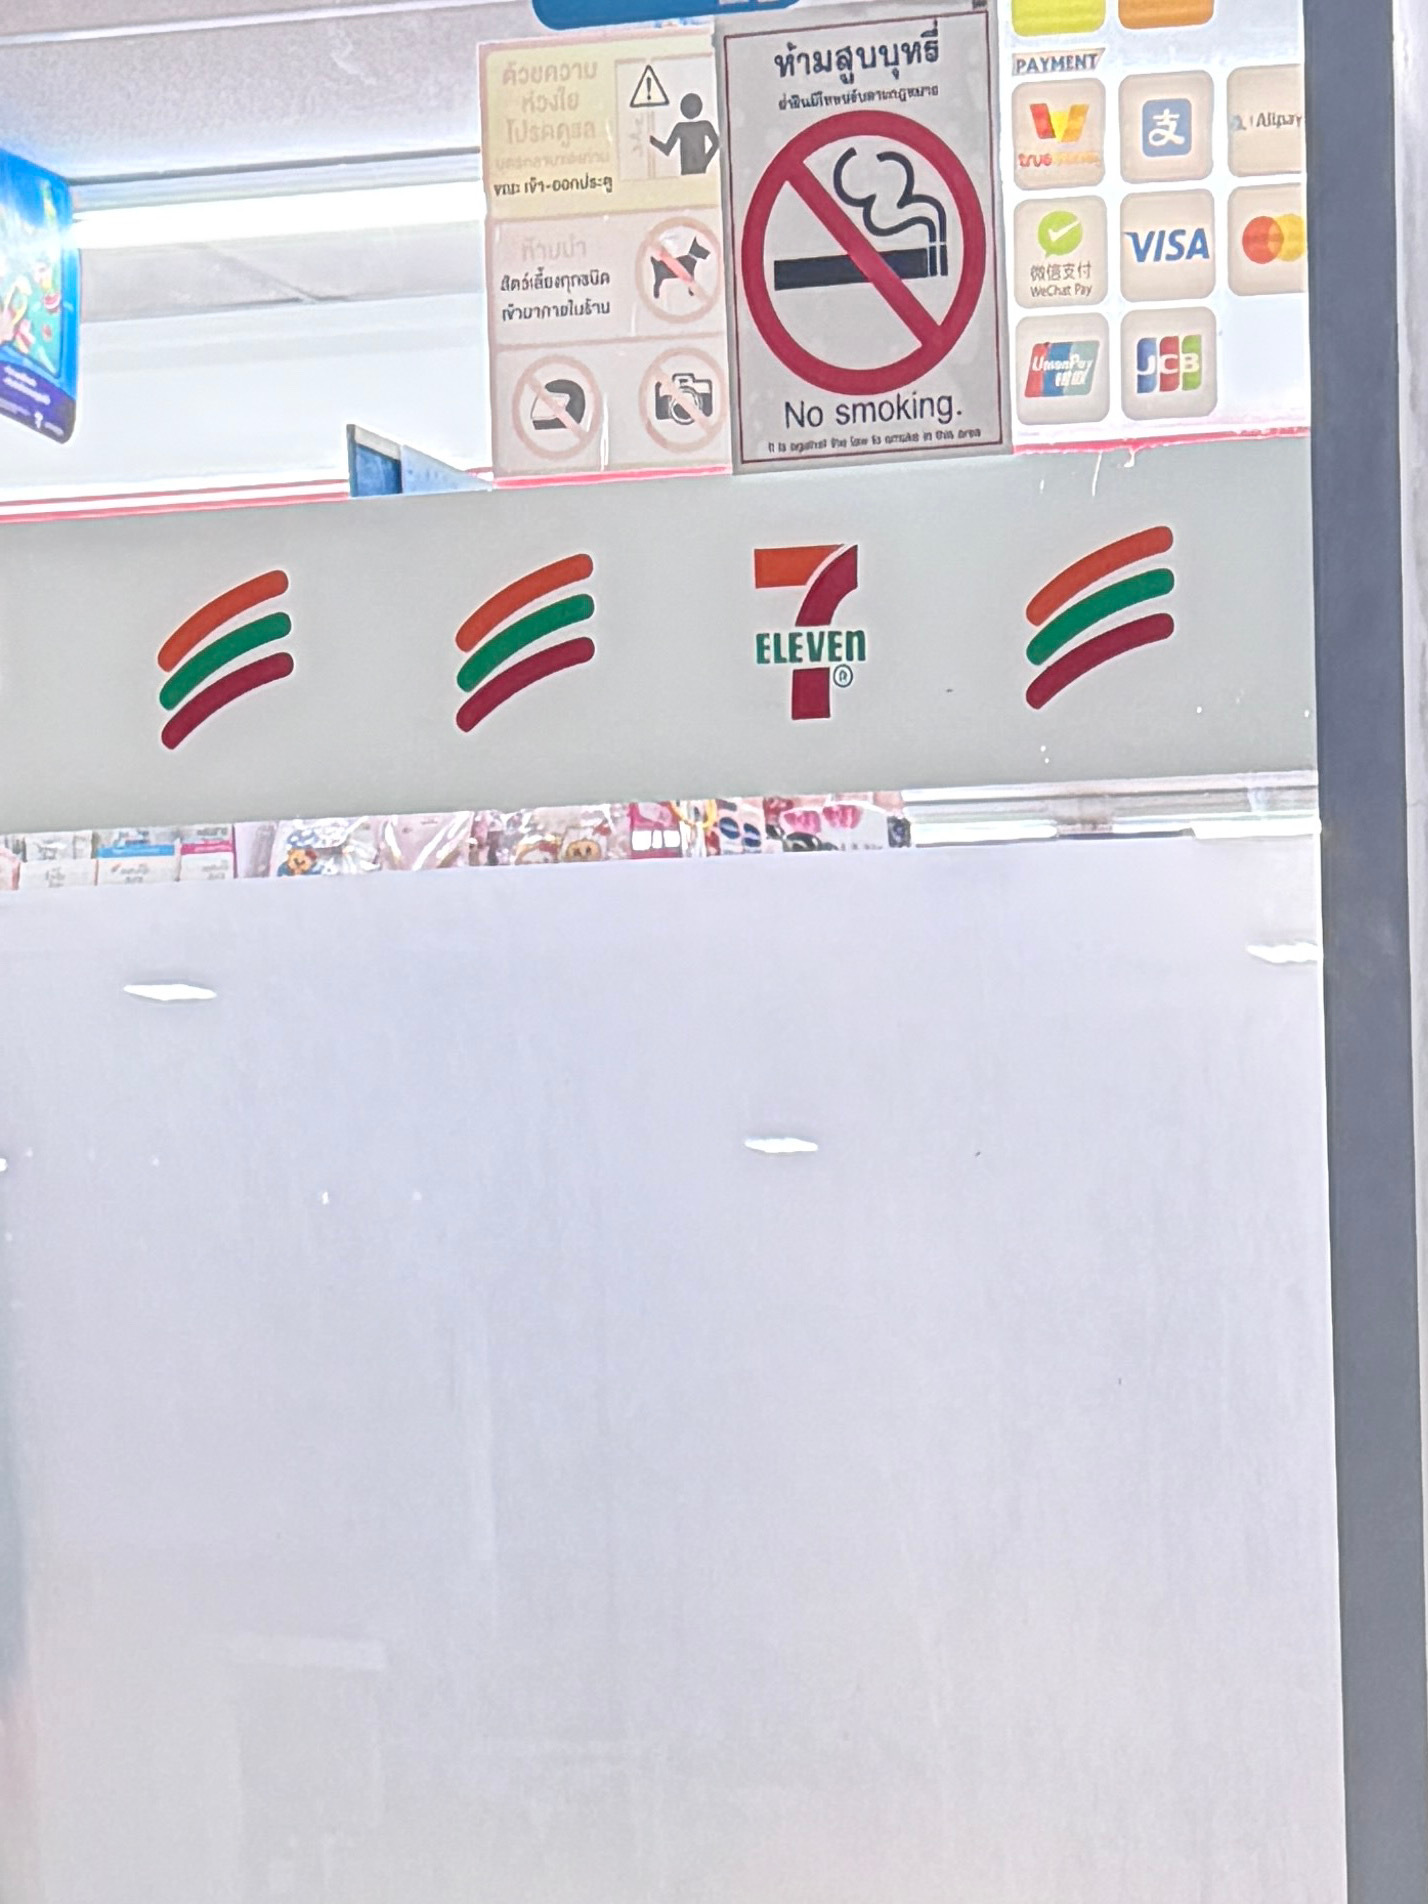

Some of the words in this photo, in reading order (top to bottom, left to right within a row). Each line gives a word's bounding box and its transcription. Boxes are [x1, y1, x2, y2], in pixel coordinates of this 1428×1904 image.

[774, 19, 939, 85] ห้ามสูบบุหรี่
[1015, 53, 1098, 74] PAYMENT
[1124, 228, 1210, 264] VISA
[1030, 260, 1092, 282] 微信支付
[1030, 284, 1072, 298] WeChat
[1075, 283, 1093, 297] Pay
[1136, 351, 1202, 378] JCB
[785, 400, 824, 429] No
[835, 390, 963, 425] smoking.
[754, 543, 859, 721] 7
